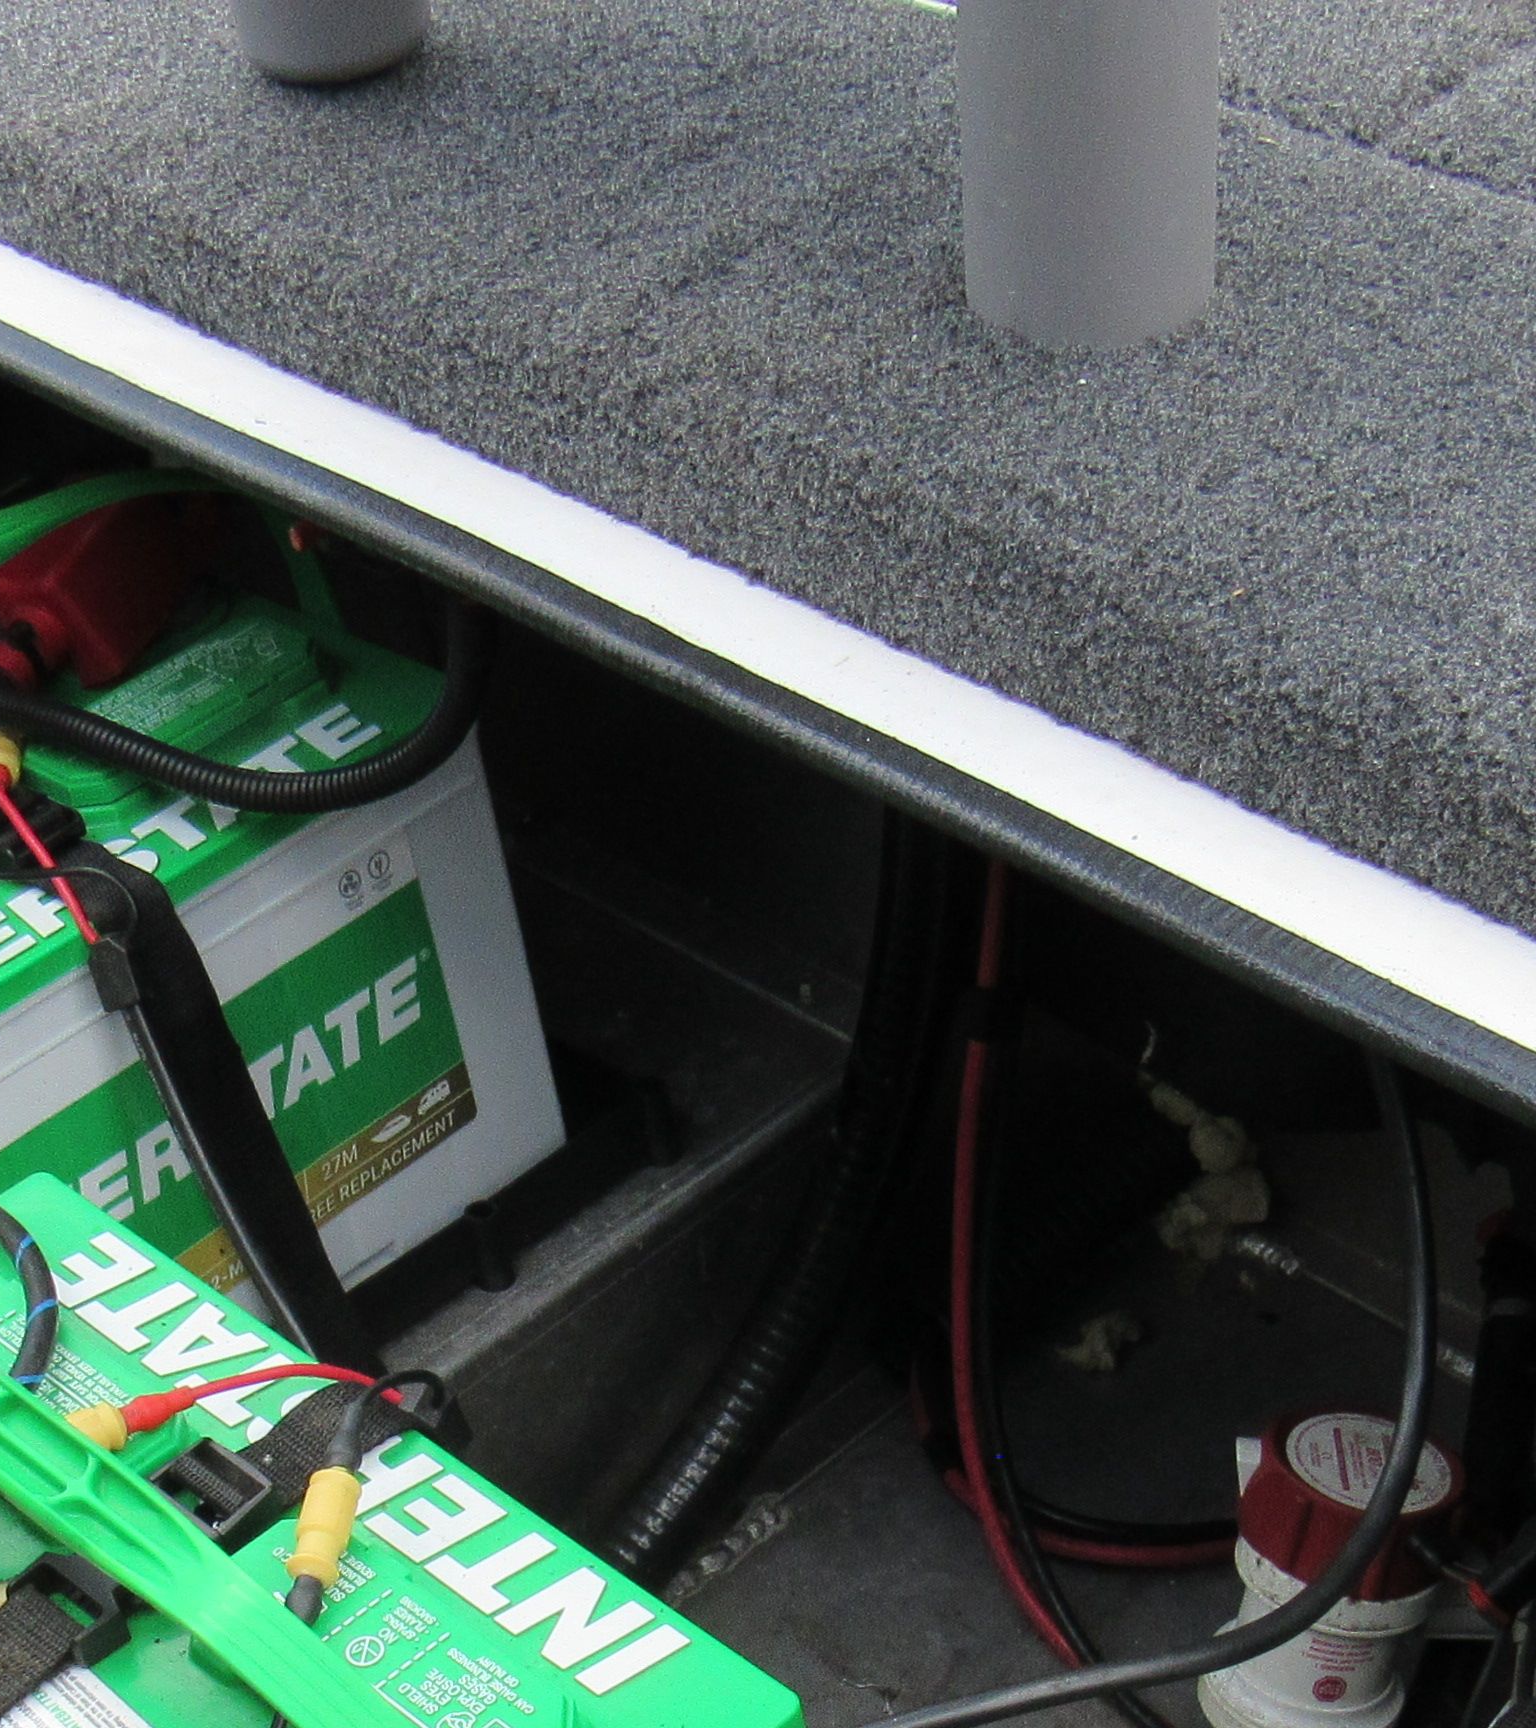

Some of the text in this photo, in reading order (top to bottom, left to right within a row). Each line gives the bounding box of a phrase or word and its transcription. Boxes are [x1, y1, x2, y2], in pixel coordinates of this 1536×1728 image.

[318, 1143, 363, 1182] 27M
[335, 1108, 461, 1203] REPLACEMENT
[52, 1390, 80, 1413] DICAL
[382, 1612, 417, 1640] SPARKS
[393, 1604, 427, 1632] FLAMES
[398, 1594, 438, 1625] SMOKING
[376, 1625, 399, 1645] NO
[446, 1646, 536, 1714] CAN CAUSE BLINDNESS
[475, 1652, 521, 1689] OR INJURY
[398, 1679, 439, 1716] SHIELD
[418, 1678, 452, 1707] EYES
[425, 1666, 486, 1716] EXPLOSIVE
[457, 1672, 498, 1706] GASES
